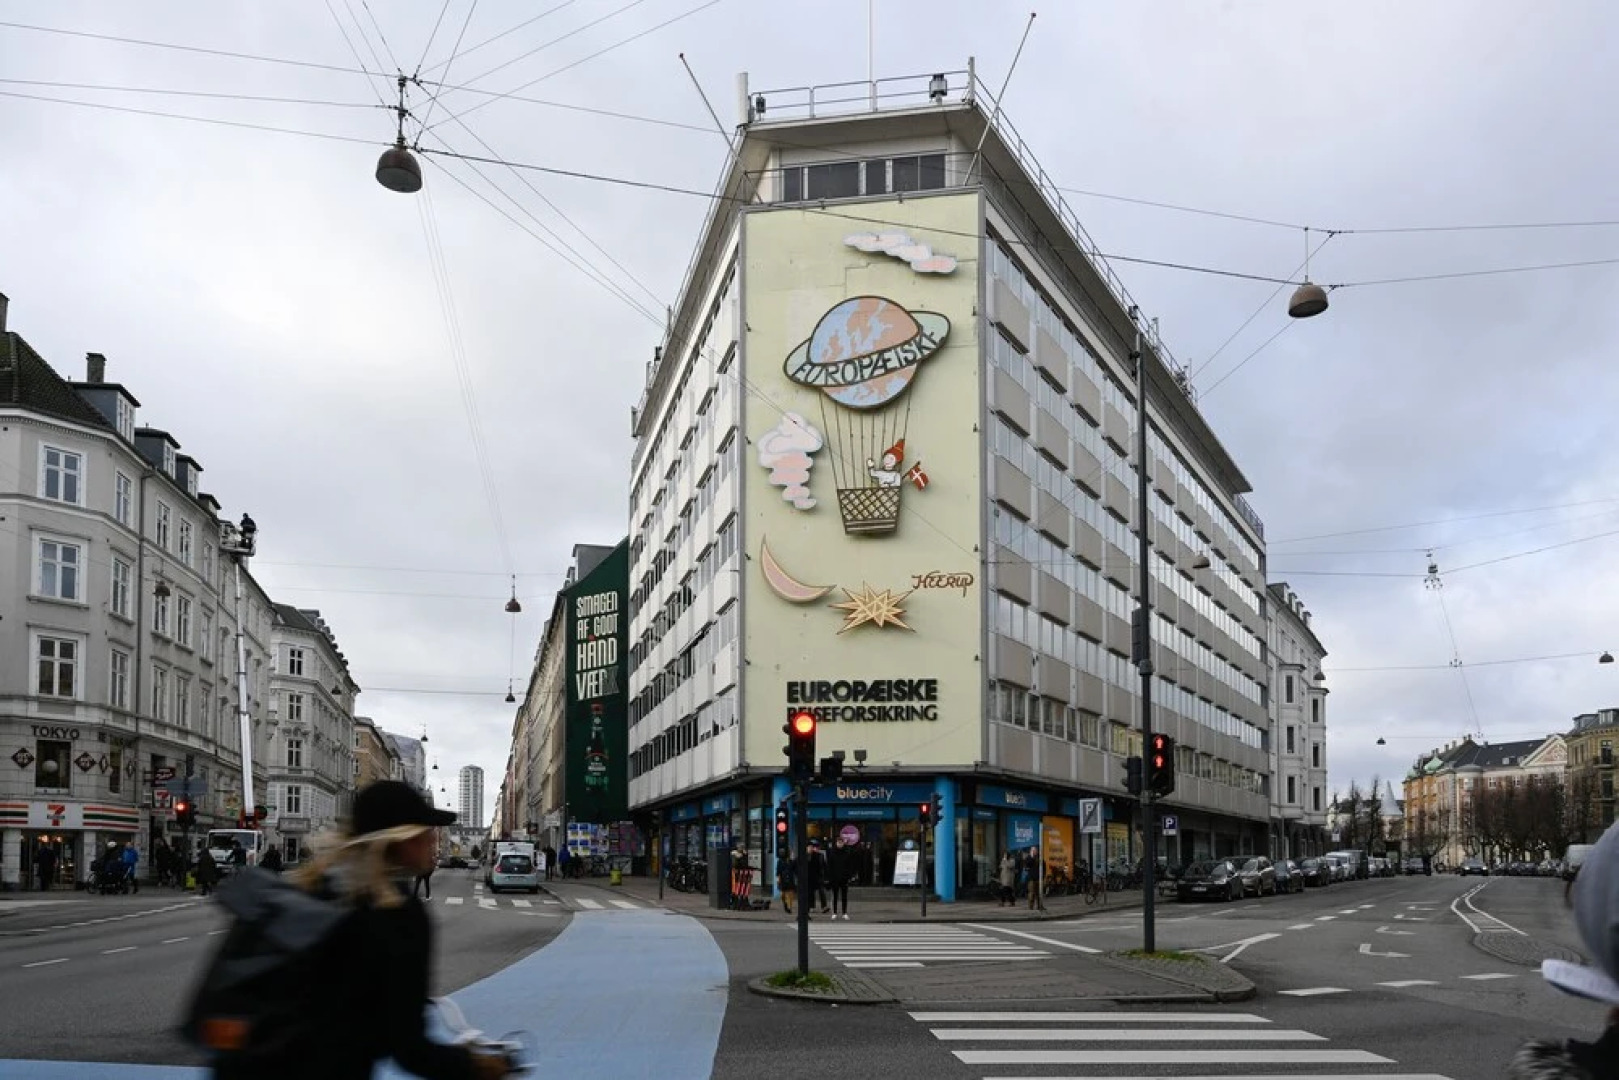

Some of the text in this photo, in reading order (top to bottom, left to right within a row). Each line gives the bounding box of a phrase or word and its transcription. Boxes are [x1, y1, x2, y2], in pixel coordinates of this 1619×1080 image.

[790, 331, 946, 385] EUROPÆISKE
[576, 591, 618, 618] SMAGEN
[577, 613, 619, 640] AF GODT
[787, 679, 938, 703] EUROPÆISKE
[31, 725, 80, 740] TOKYO
[836, 786, 894, 801] bluecity
